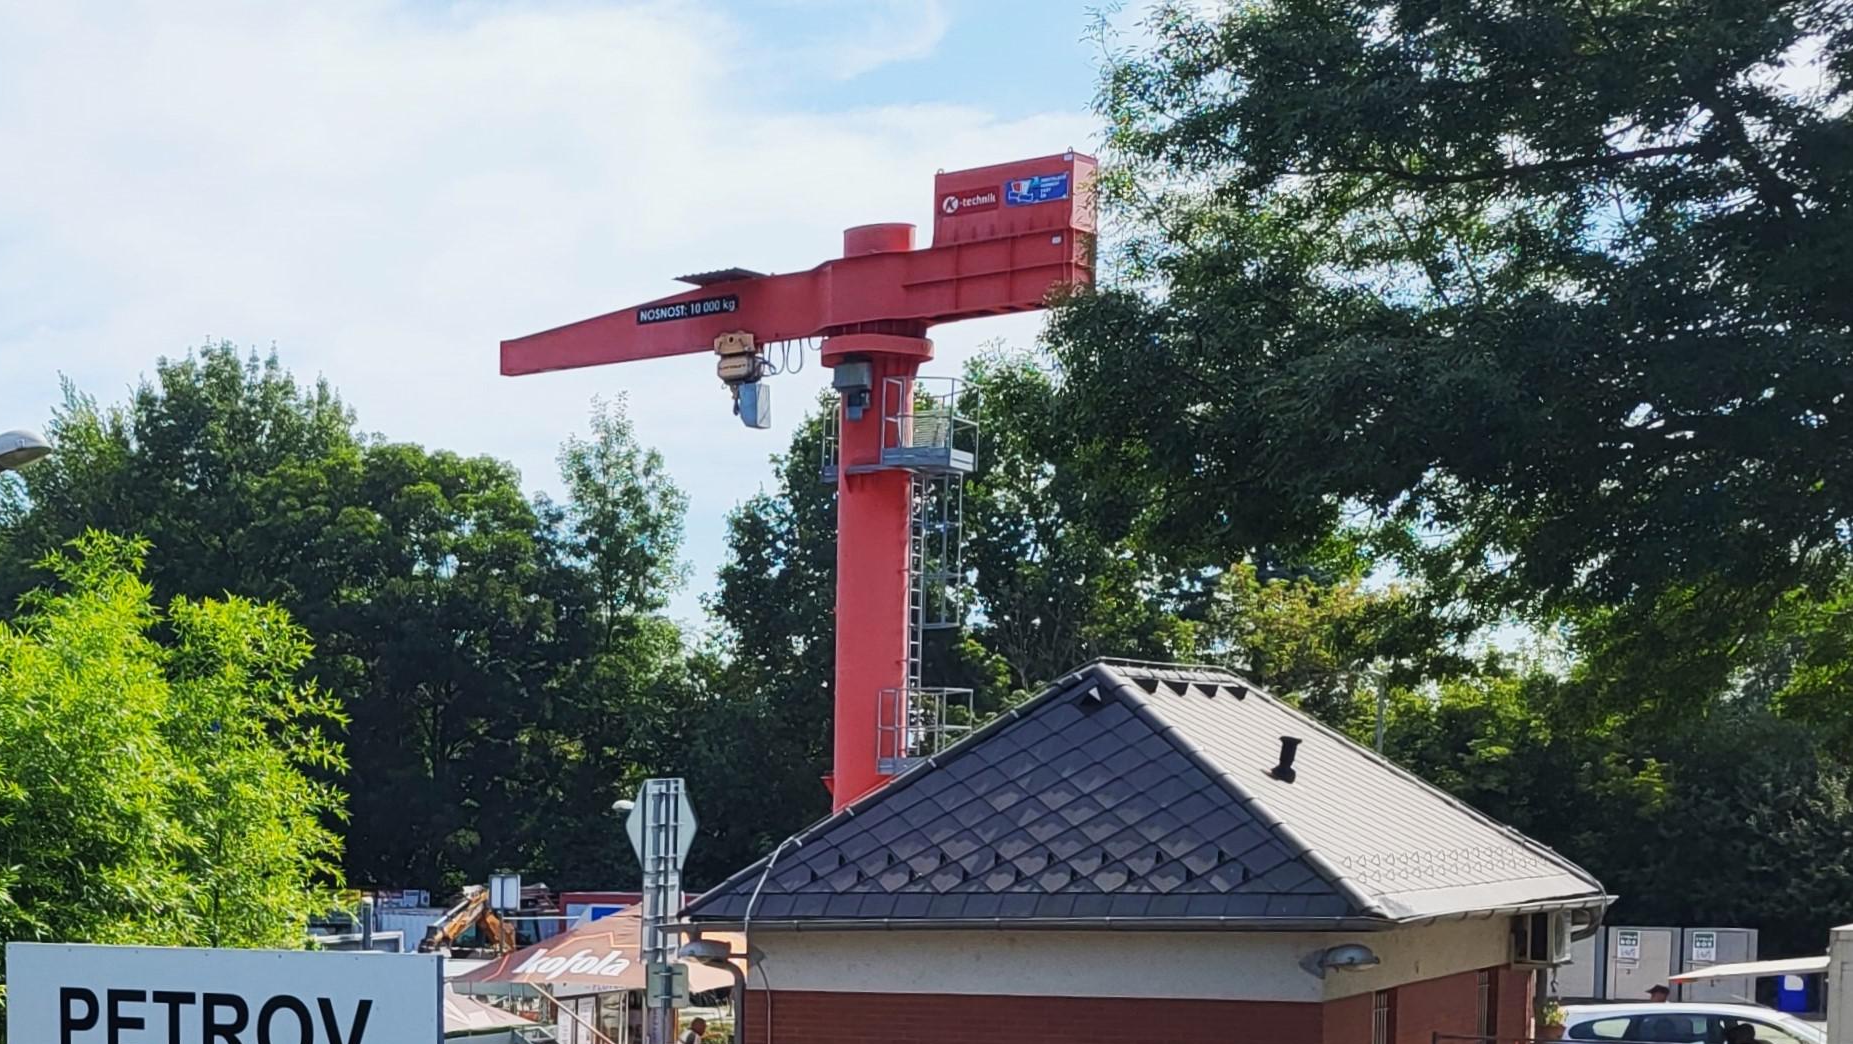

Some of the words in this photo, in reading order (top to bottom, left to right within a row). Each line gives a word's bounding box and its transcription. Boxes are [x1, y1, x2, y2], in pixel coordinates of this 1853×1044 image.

[640, 305, 688, 322] NOSNOST:
[691, 303, 701, 315] 10
[703, 299, 721, 313] 000
[722, 298, 736, 312] kg
